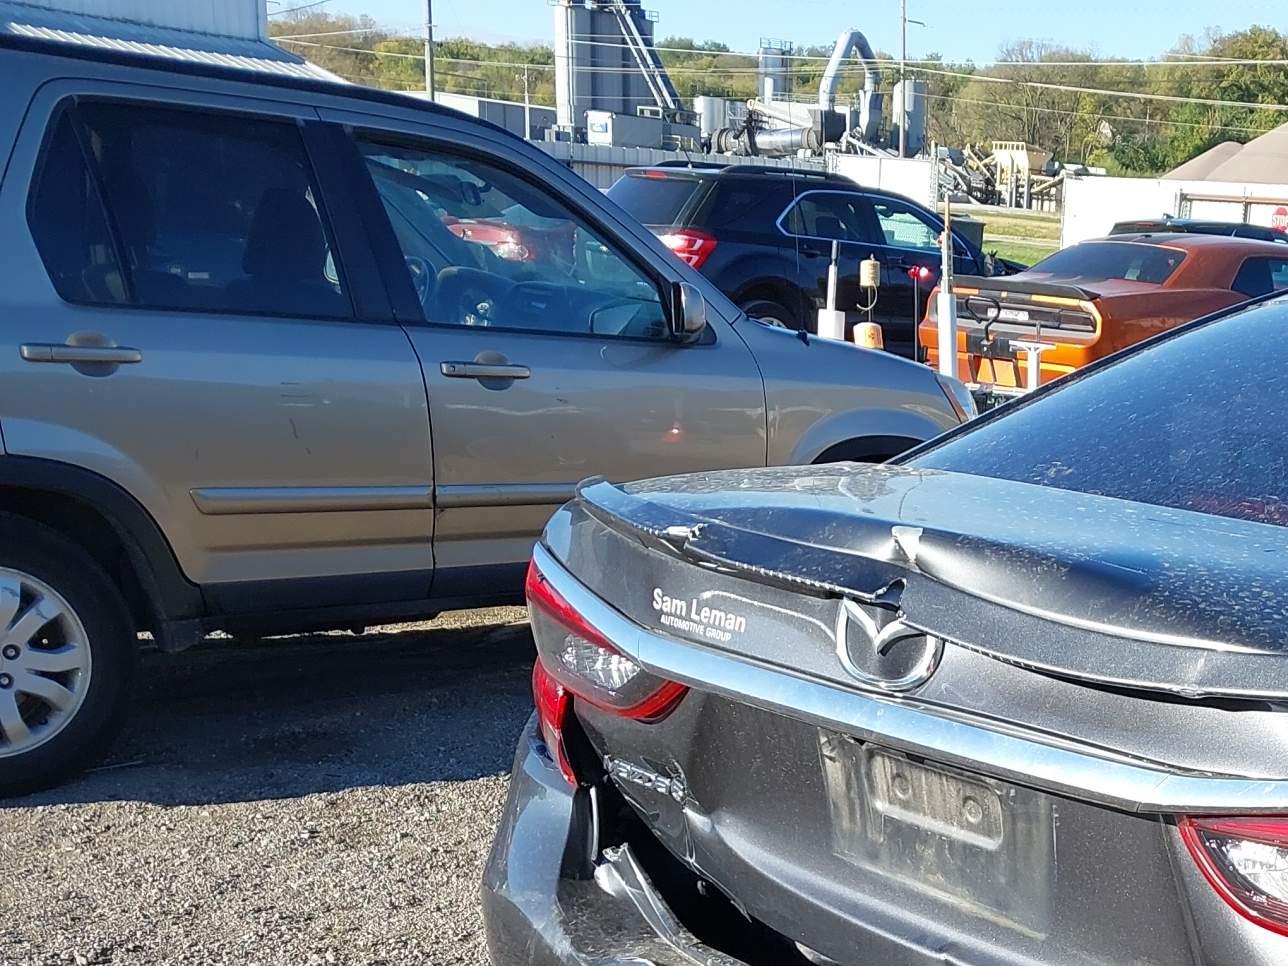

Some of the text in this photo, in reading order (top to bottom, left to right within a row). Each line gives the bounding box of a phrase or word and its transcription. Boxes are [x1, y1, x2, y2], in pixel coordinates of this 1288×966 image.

[652, 587, 747, 633] Sam Leman
[660, 614, 732, 642] AUTOMOTIVE GROUP
